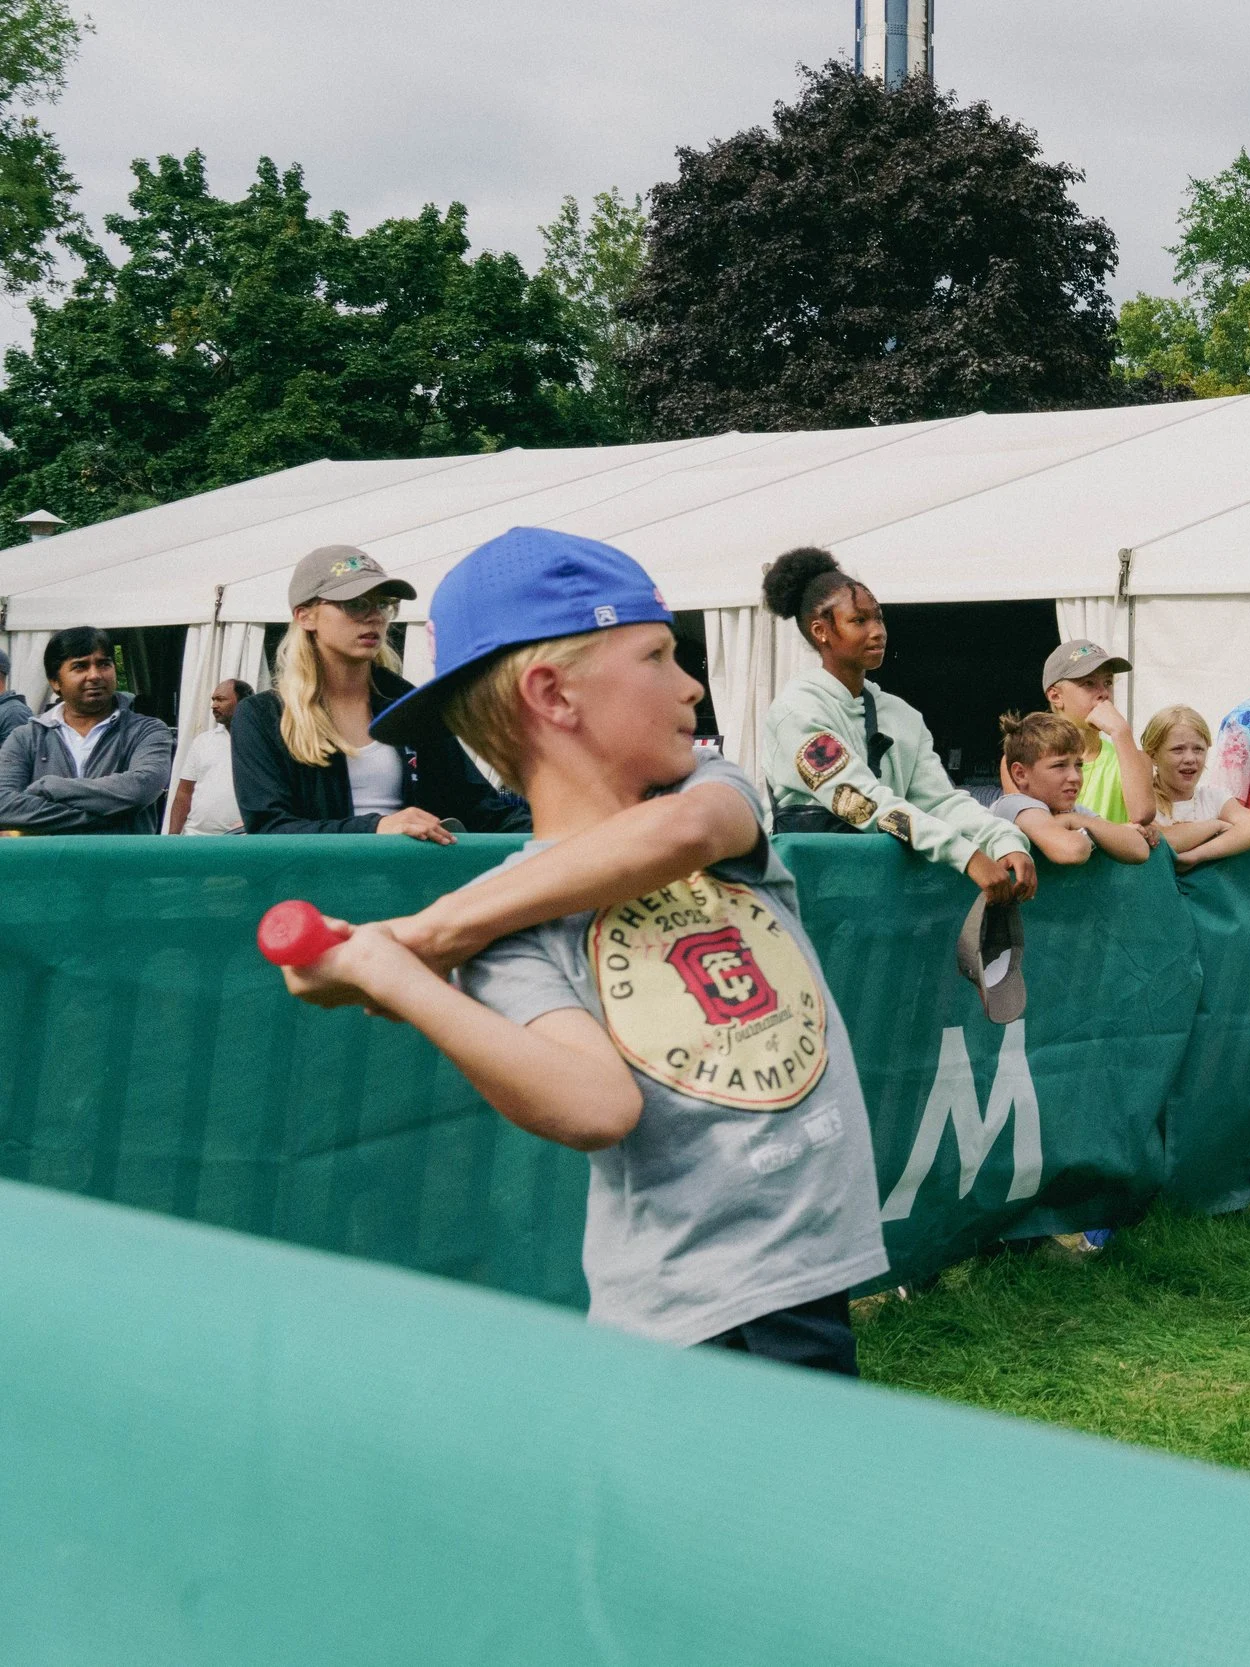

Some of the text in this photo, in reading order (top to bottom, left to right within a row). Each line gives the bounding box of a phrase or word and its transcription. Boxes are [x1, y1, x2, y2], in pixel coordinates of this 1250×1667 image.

[607, 887, 678, 1000] GOPHER
[666, 991, 819, 1092] CHAMPIONS
[880, 1018, 1043, 1223] M
